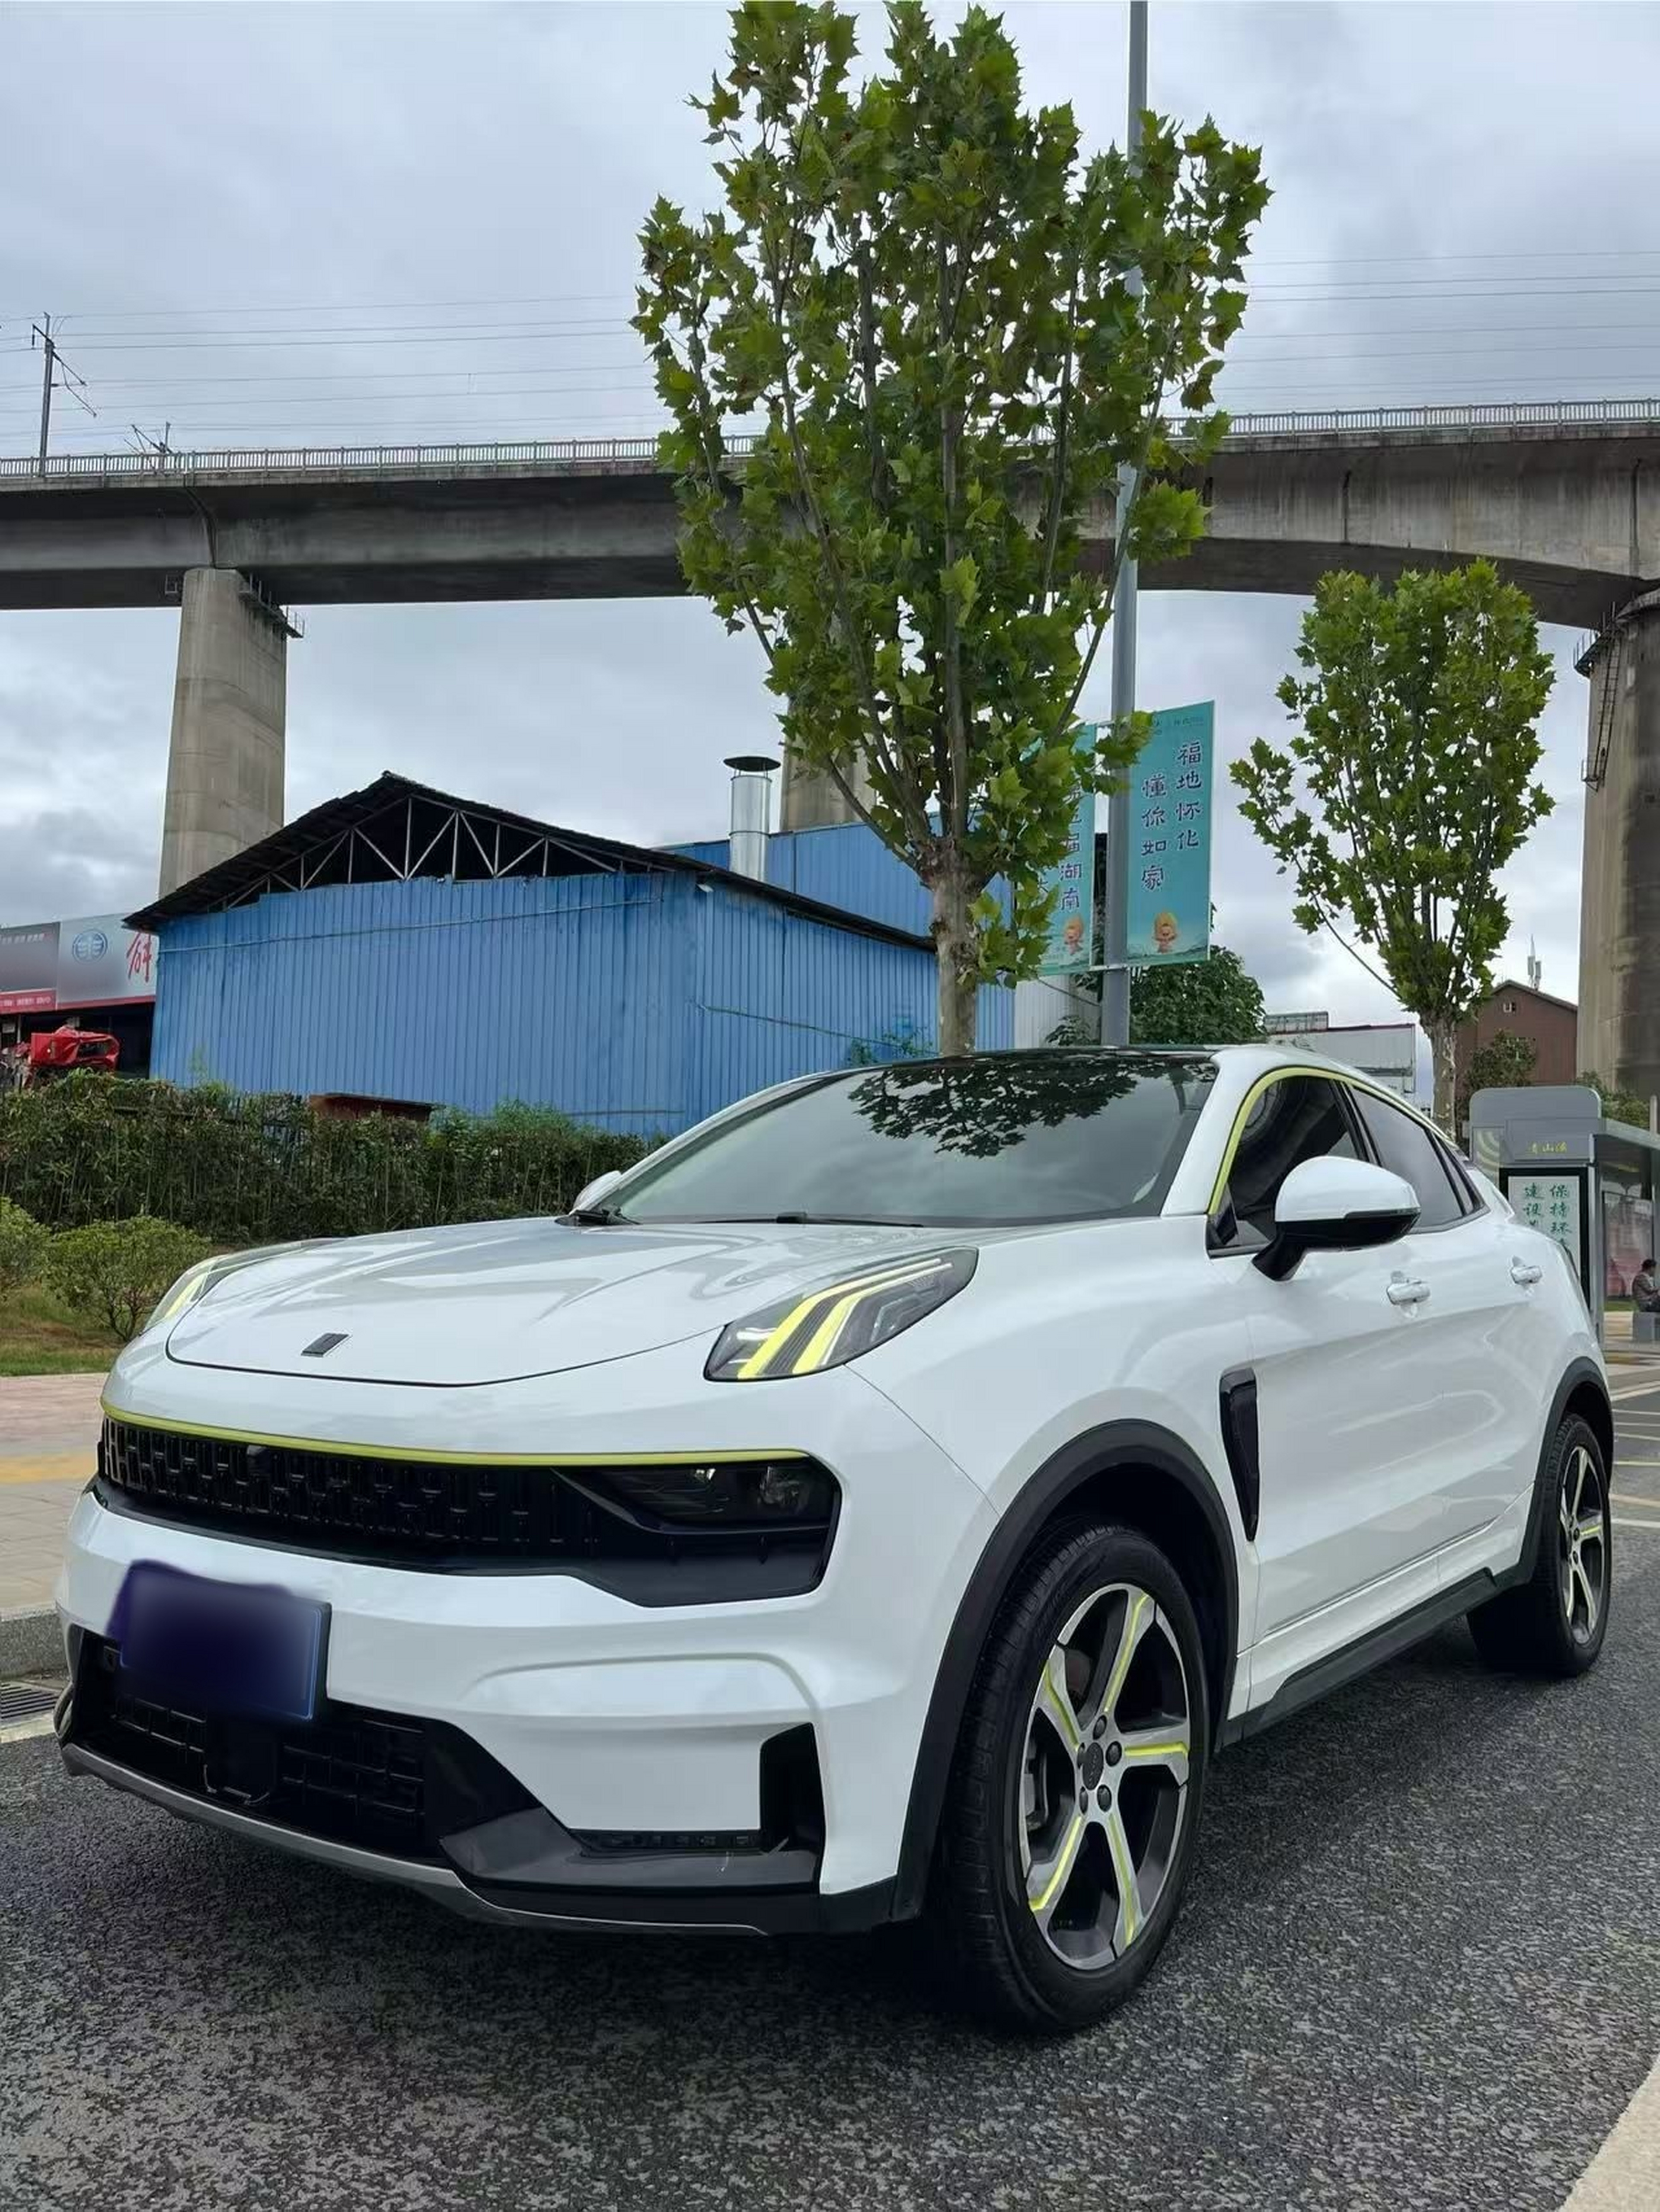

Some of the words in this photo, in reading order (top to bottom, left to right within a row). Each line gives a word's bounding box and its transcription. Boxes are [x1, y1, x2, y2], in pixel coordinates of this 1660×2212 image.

[1142, 774, 1167, 891] 懂你如家
[1175, 741, 1202, 851] 福地怀化
[1523, 1182, 1544, 1225] 建设
[1550, 1185, 1572, 1244] 保持环
